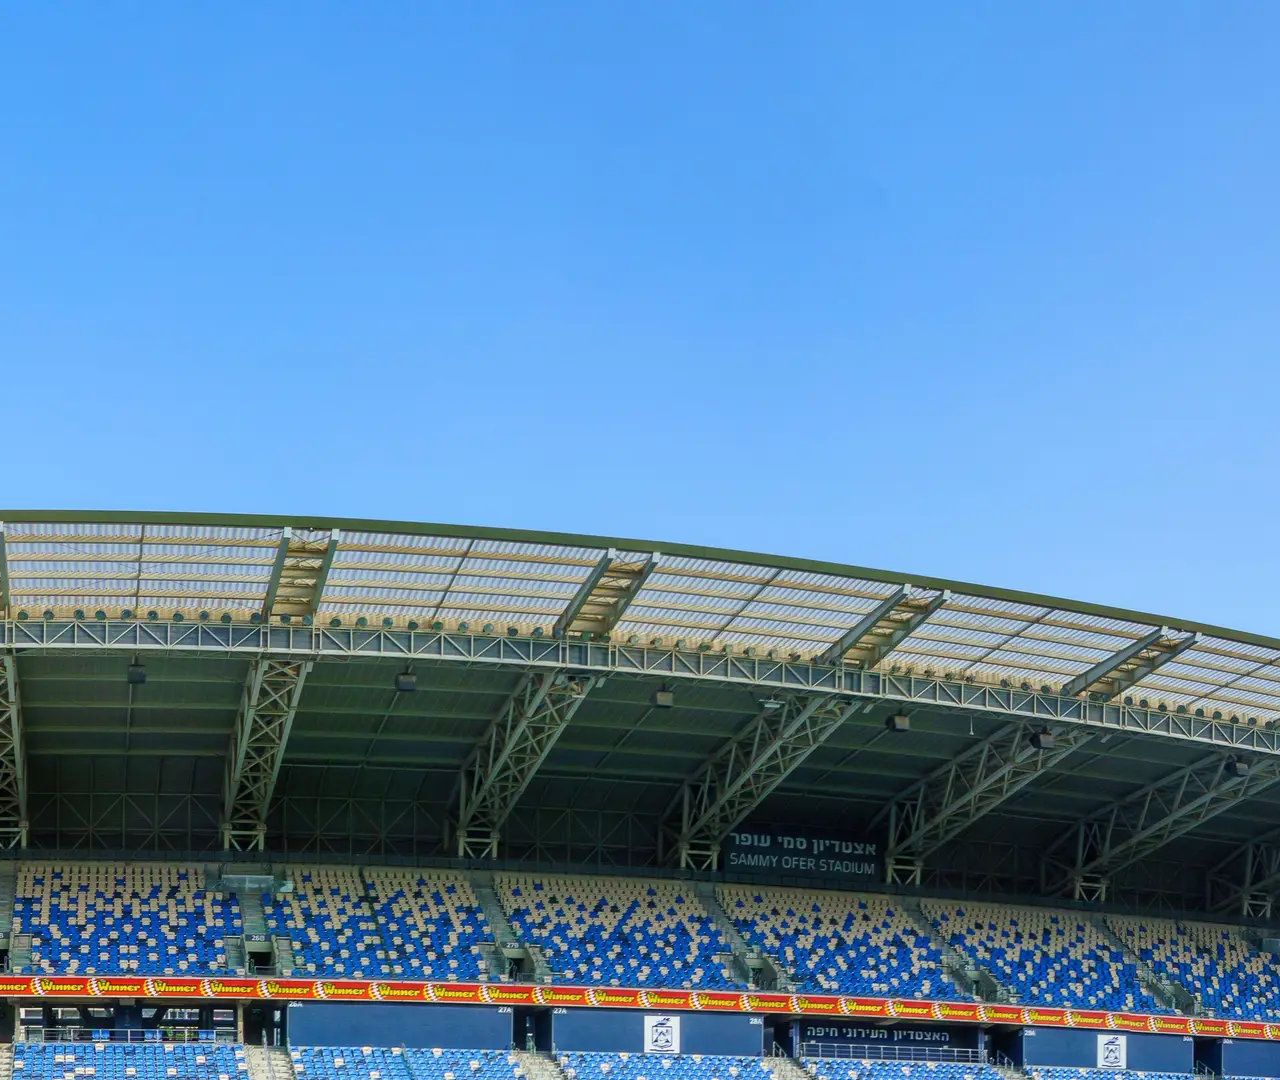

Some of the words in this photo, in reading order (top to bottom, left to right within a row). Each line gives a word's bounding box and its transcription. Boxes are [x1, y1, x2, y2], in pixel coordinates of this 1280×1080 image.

[729, 832, 771, 847] עופר
[777, 837, 807, 850] סמי
[812, 839, 877, 855] אצטדיון
[730, 853, 778, 867] SAMMY
[782, 856, 816, 871] OFER
[820, 859, 875, 875] STADIUM
[807, 1026, 838, 1037] חיפה
[842, 1027, 888, 1038] העירוני
[893, 1029, 950, 1041] האצטדיון
